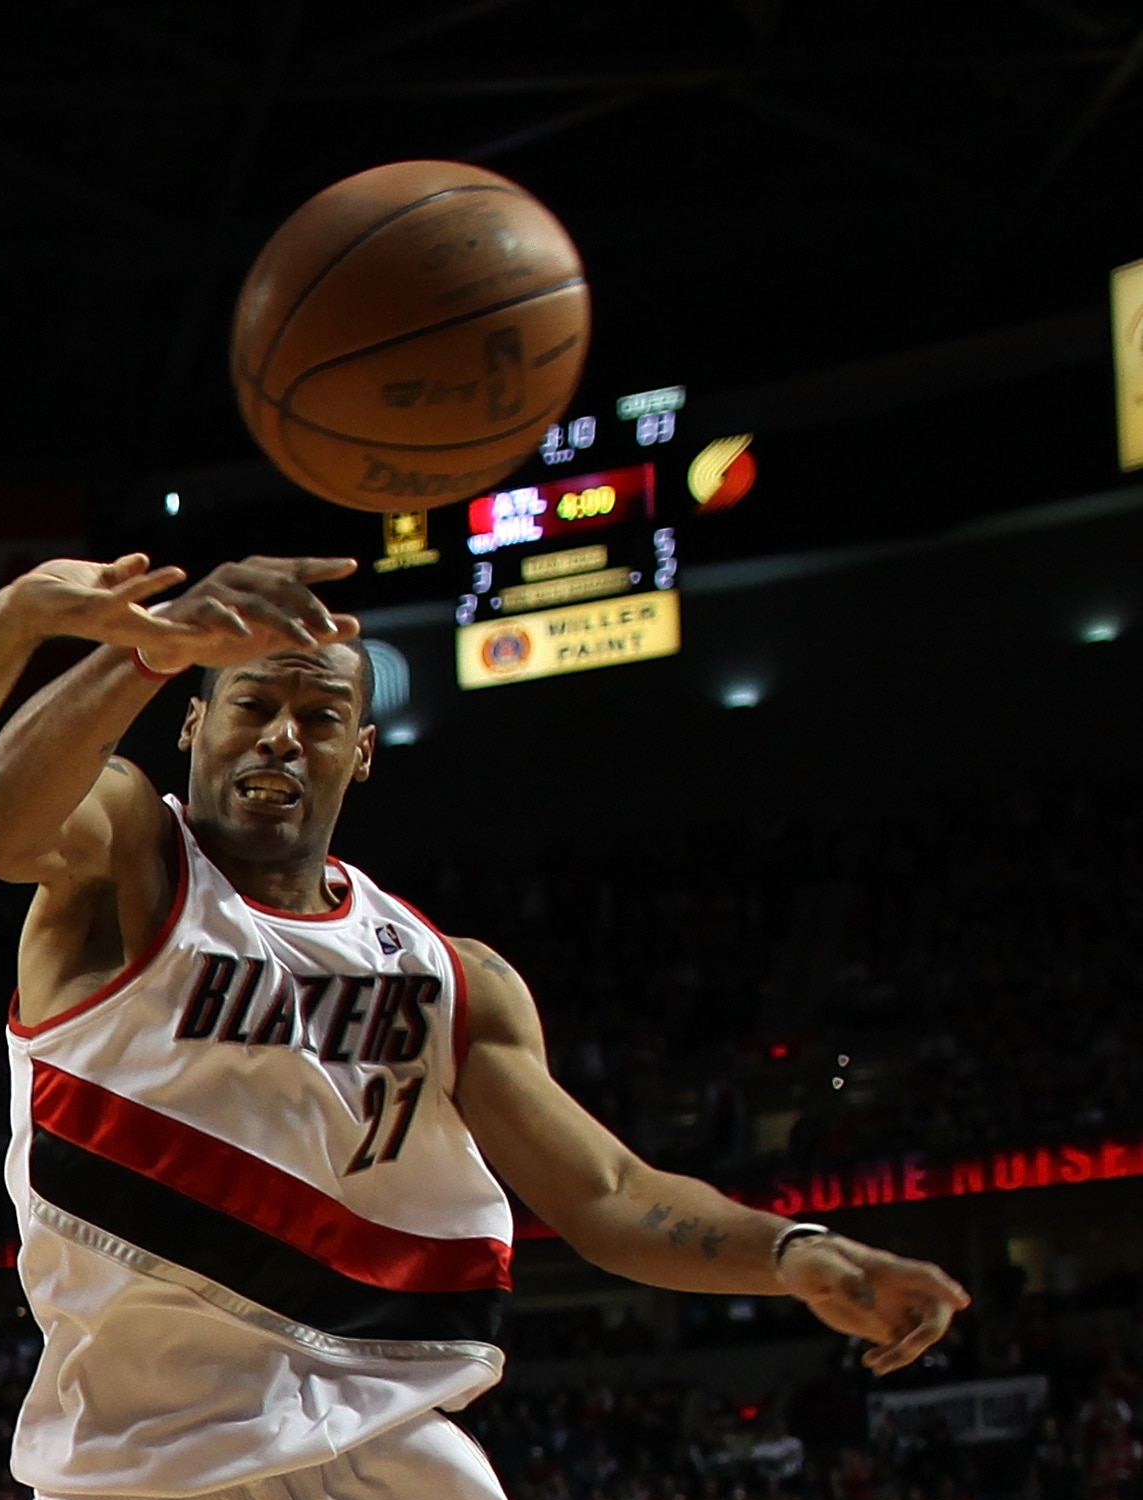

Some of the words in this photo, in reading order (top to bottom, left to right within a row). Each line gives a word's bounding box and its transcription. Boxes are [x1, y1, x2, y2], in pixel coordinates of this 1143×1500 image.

[559, 634, 644, 660] PAINT
[174, 953, 442, 1064] BLAZERS
[341, 1075, 425, 1178] 21
[952, 1141, 1130, 1197] NOISE
